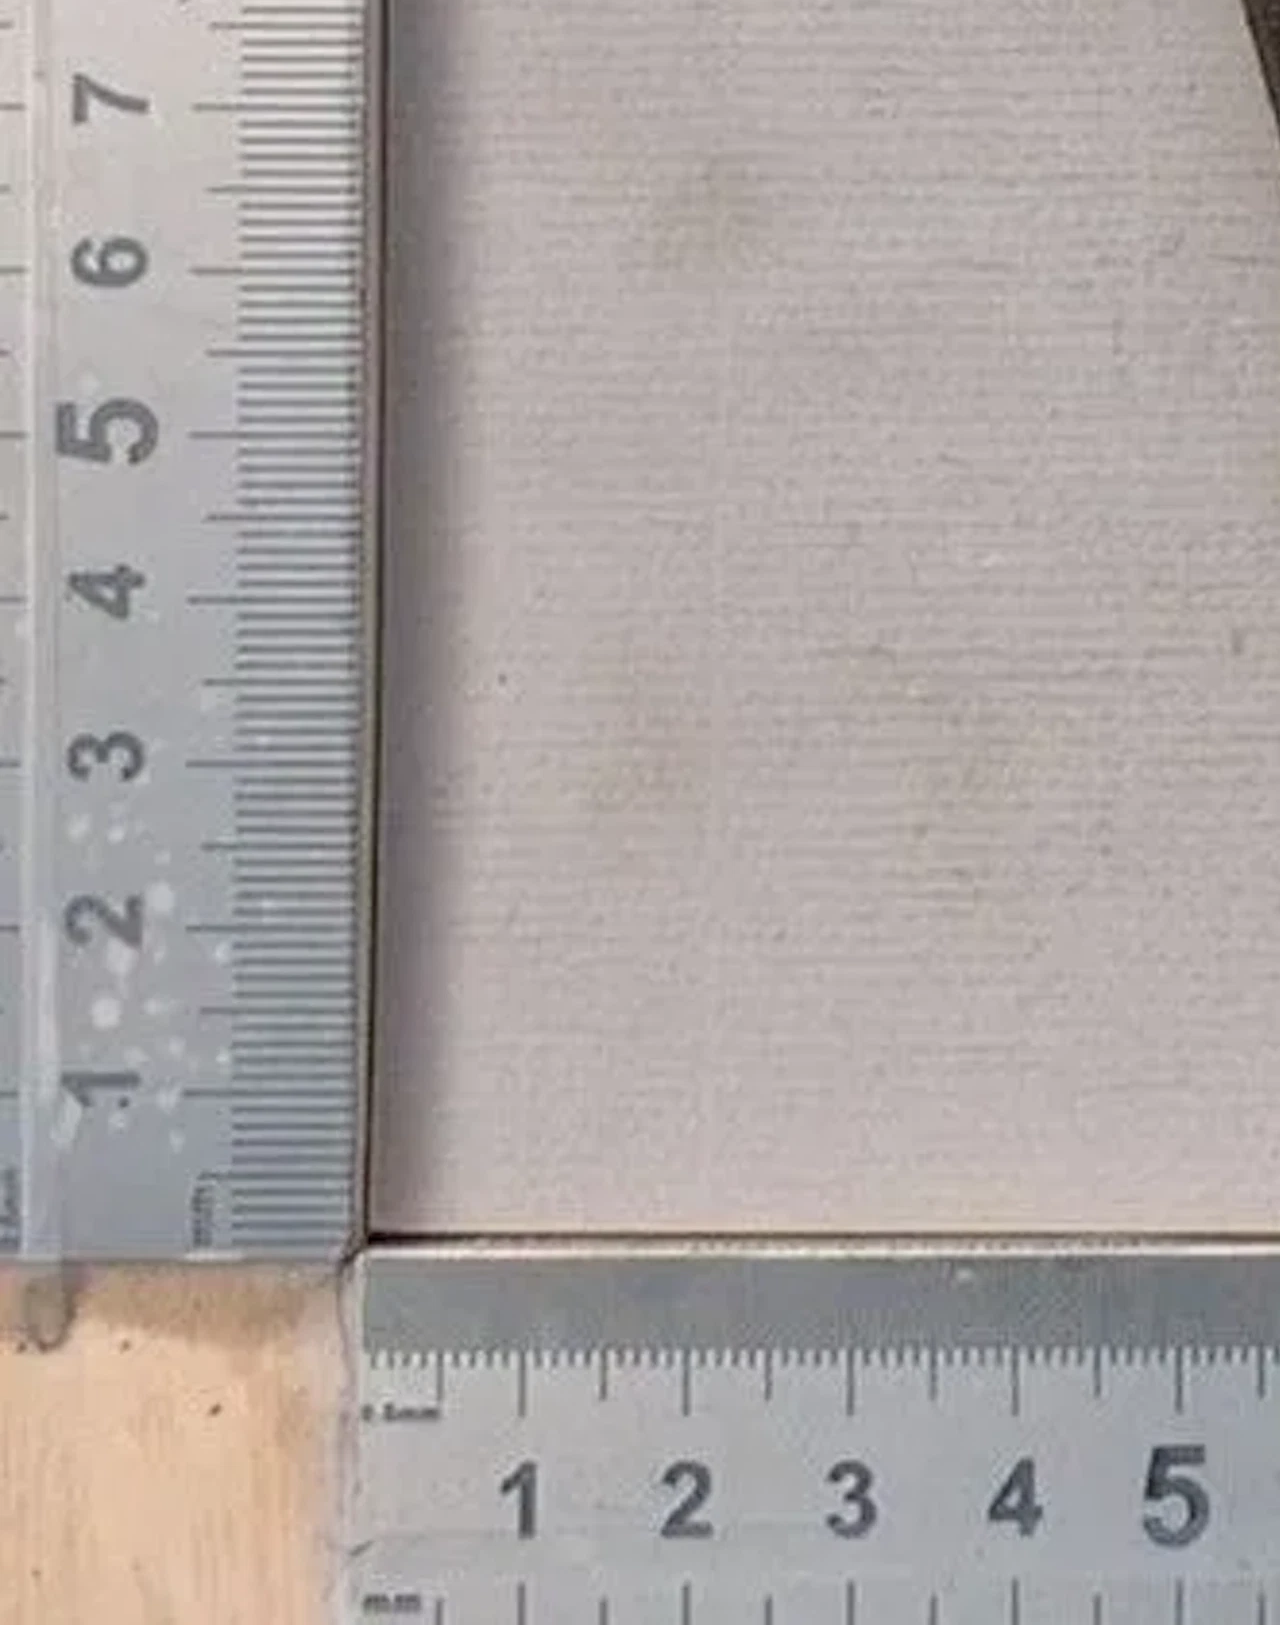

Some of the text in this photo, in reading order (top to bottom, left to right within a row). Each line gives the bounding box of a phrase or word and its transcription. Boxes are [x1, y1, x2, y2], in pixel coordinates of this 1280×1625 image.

[73, 74, 148, 124] 7
[71, 238, 148, 288] 6
[56, 399, 158, 465] 5
[68, 565, 145, 620] 4
[67, 732, 144, 781] 3
[63, 895, 143, 947] 2
[62, 1072, 141, 1108] 1
[501, 1462, 536, 1538] 1
[661, 1462, 712, 1538] 2
[827, 1462, 876, 1538] 3
[988, 1459, 1042, 1535] 4
[1144, 1446, 1208, 1546] 5
